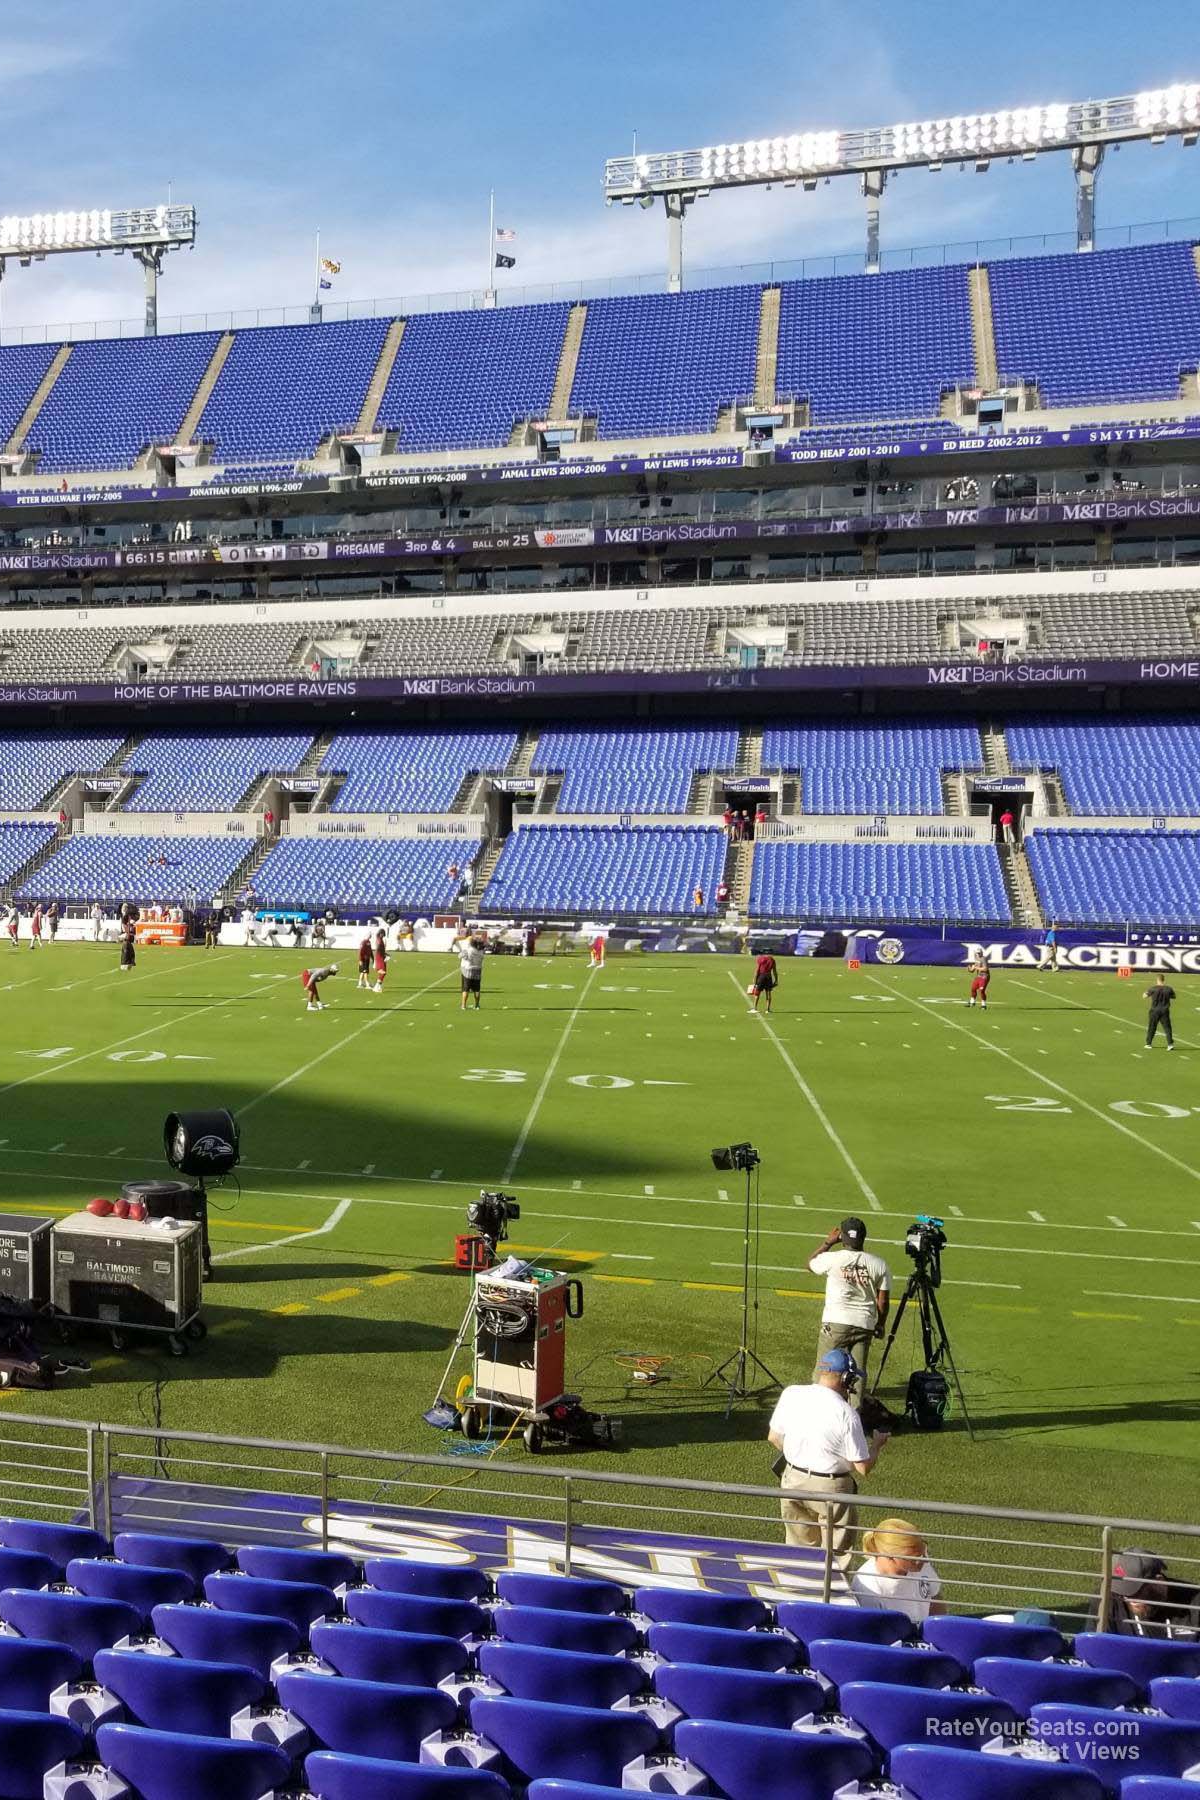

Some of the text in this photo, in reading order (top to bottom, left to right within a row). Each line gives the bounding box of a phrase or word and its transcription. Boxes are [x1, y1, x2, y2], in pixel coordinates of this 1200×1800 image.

[1090, 428, 1152, 442] SMYTH
[943, 435, 1042, 451] ED REED 2002-2012
[791, 446, 900, 460] TODD HEAP 2001-2010
[644, 456, 738, 470] RAY LEWIS 1996-2012
[500, 464, 607, 480] JAMAL LEWIS 2000-2006
[366, 473, 467, 487] MATT STOVER 1996-2008
[189, 483, 303, 497] JONATHAN OGDEN 1996-2007
[17, 492, 122, 506] PETER BOULWARE 1997-2005
[1063, 503, 1106, 520] M&T
[1106, 502, 1147, 518] Bank
[604, 524, 736, 543] M&T Bank Stadium
[335, 542, 385, 556] PREGAME
[430, 540, 442, 551] &
[446, 539, 456, 551] 4
[472, 535, 529, 549] BALL ON 25
[2, 553, 108, 569] M&T Bank Stadium
[126, 552, 165, 564] 66:15
[927, 664, 1087, 684] M&T Bank Stadium
[1141, 662, 1200, 679] HOME
[114, 682, 357, 700] HOME OF THE BALTIMORE RAVENS
[402, 678, 535, 694] M&T Bank Stadium
[28, 687, 77, 701] Stadium
[850, 961, 859, 969] 20
[1120, 968, 1129, 977] 10
[459, 1238, 485, 1266] 30
[1, 1267, 12, 1278] #3
[86, 1261, 142, 1275] BALTIMORE
